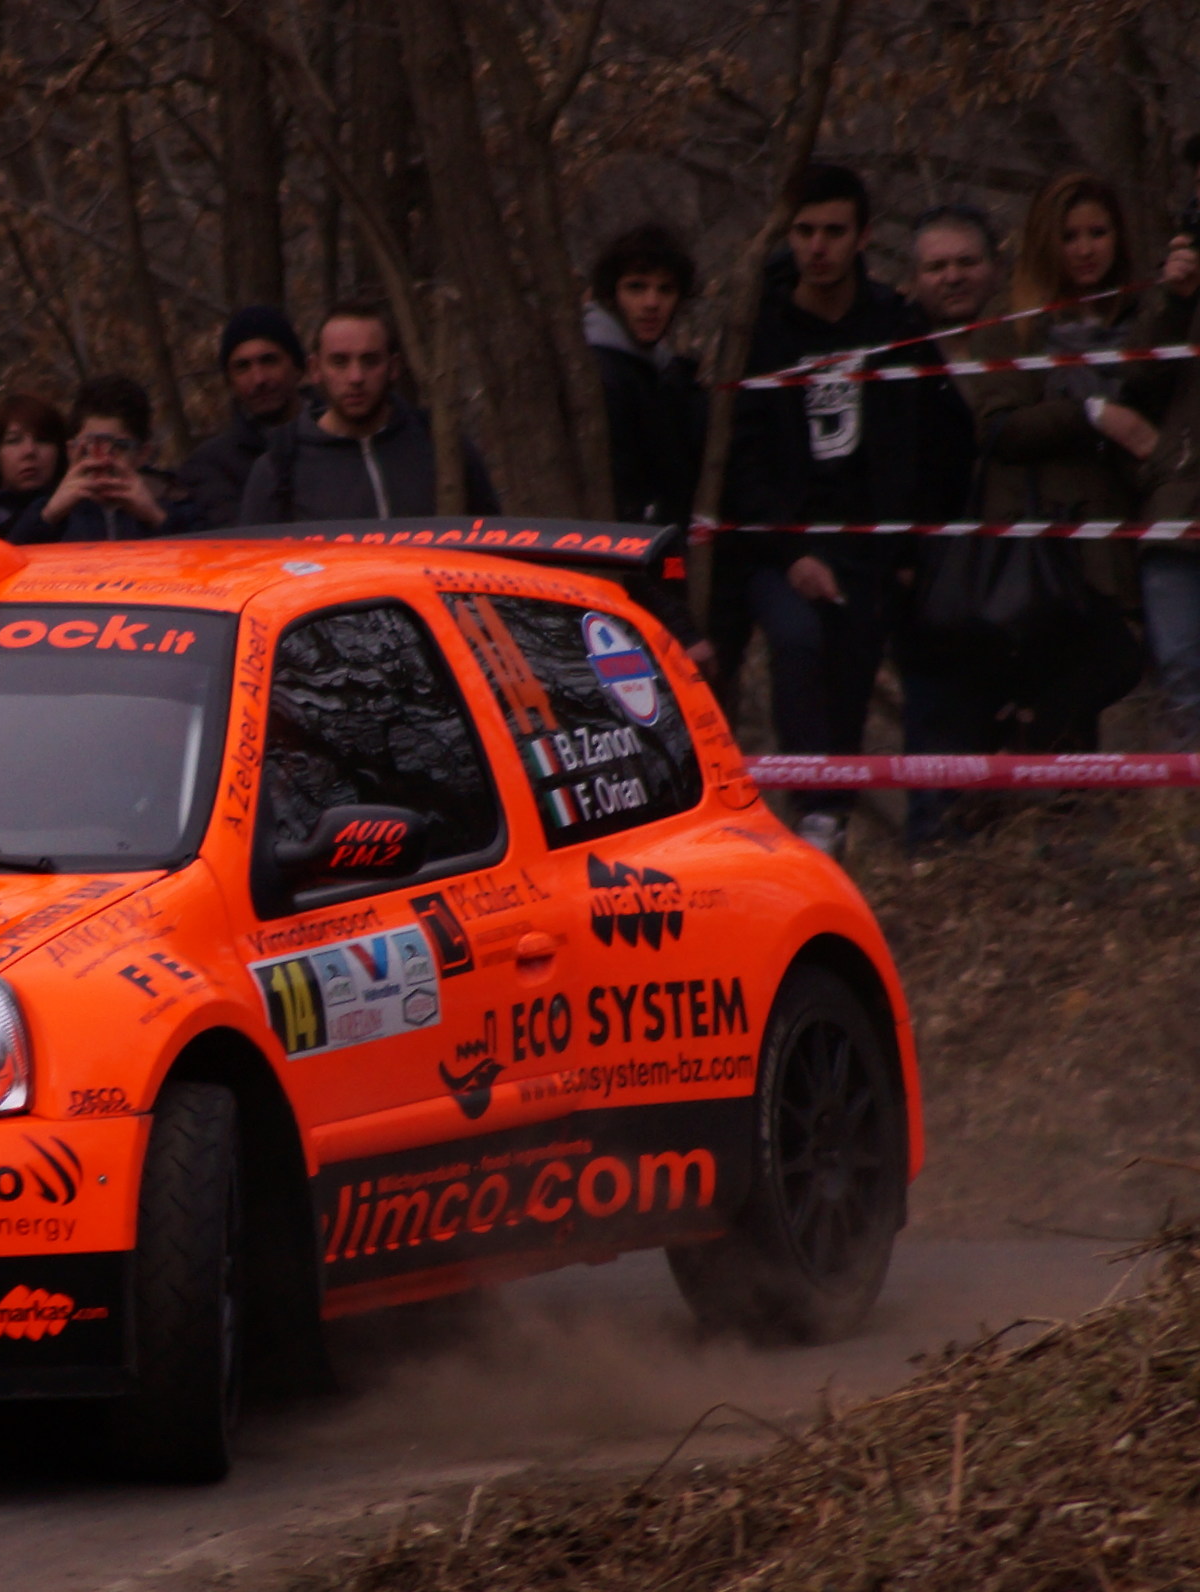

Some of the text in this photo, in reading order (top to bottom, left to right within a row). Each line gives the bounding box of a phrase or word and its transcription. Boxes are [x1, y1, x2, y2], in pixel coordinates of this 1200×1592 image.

[240, 616, 271, 697] Albert
[230, 716, 267, 811] Zelger
[555, 725, 642, 772] B.Zanon
[747, 765, 871, 783] RICOLOSA
[1012, 764, 1170, 782] PERICOLOSA
[334, 819, 408, 844] AUTO
[247, 904, 384, 956] Vimotorsport
[270, 960, 318, 1052] 14
[512, 976, 750, 1064] ECO SYSTEM
[322, 1148, 716, 1264] limco.com
